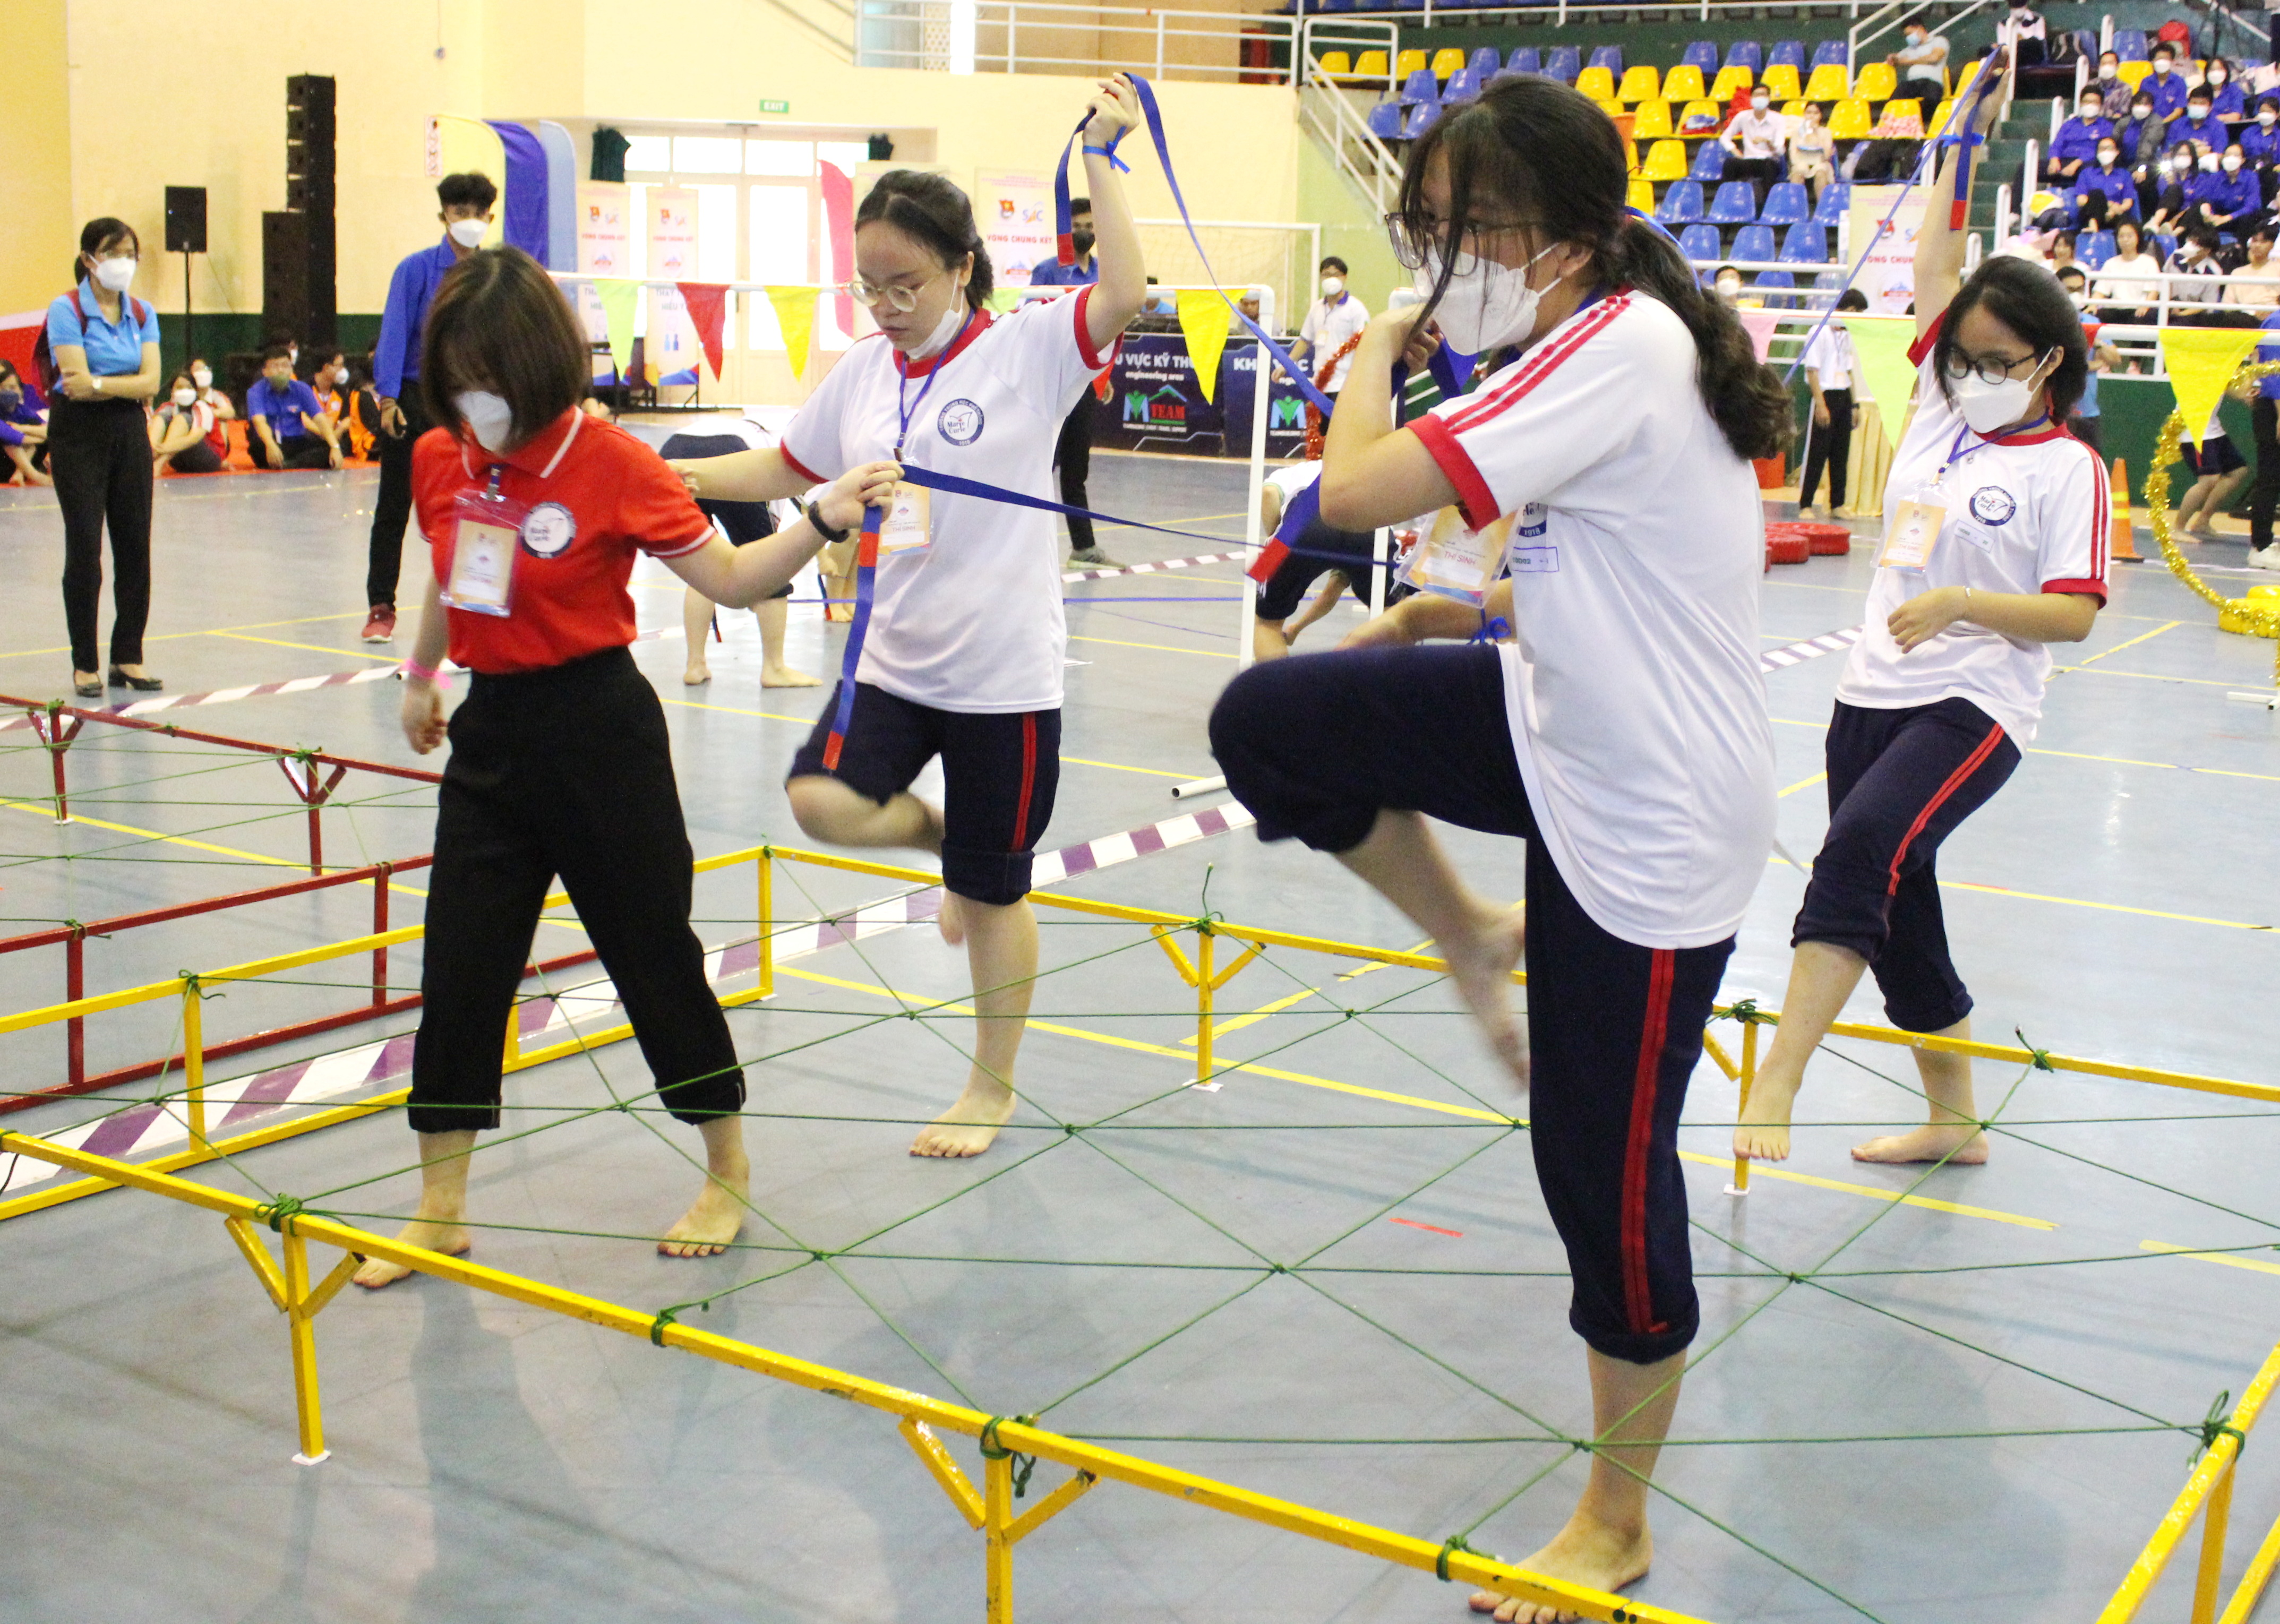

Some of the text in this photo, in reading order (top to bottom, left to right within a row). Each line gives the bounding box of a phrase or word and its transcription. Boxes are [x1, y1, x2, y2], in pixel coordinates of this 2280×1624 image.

[1125, 352, 1151, 369] VỰC
[1153, 351, 1171, 367] KỸ
[1233, 357, 1257, 371] KH
